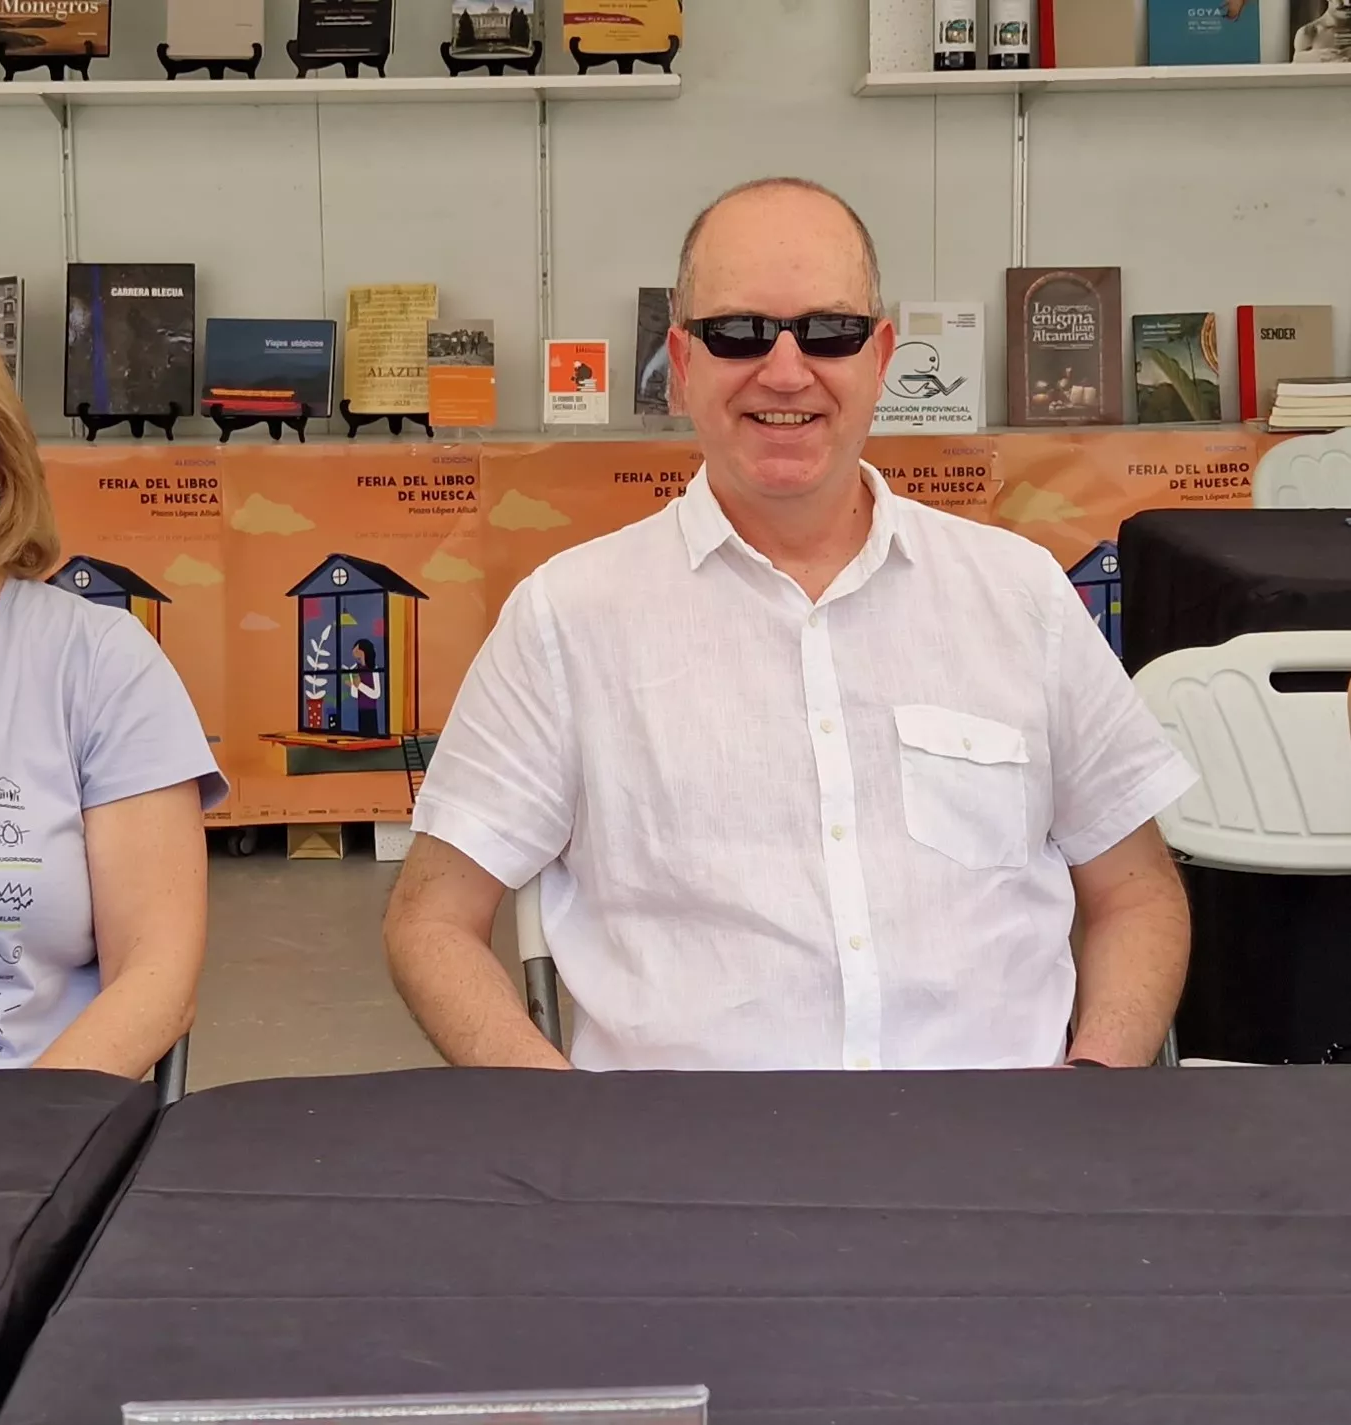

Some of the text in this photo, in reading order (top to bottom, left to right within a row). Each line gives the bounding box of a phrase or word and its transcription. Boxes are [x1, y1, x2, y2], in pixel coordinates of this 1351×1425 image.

[0, 0, 99, 20] Monegros
[1188, 8, 1222, 16] GOYA
[110, 287, 184, 297] CARRERA BLECUA
[1034, 302, 1051, 314] Lo
[1032, 310, 1095, 329] enigma
[1032, 330, 1095, 342] Altamiras
[1261, 328, 1296, 340] SENDER
[265, 339, 289, 348] Viajes
[367, 366, 424, 377] ALAZET
[875, 404, 971, 413] SOCIACIÓN PROVINCIAL
[939, 414, 973, 422] HUESCA
[913, 467, 937, 477] DEL
[944, 466, 985, 477] LIBRO
[1128, 463, 1249, 475] FERIA DEL LIBRO
[356, 475, 475, 487] FERIA DEL LIBRO
[614, 472, 684, 483] FERIA DEL
[1170, 477, 1251, 489] DE HUESCA
[98, 478, 218, 489] FERIA DEL LIBRO
[907, 482, 985, 493] DE HUESCA
[398, 490, 477, 501] DE HUESCA
[654, 487, 672, 498] DE
[140, 494, 219, 504] DE HUESCA
